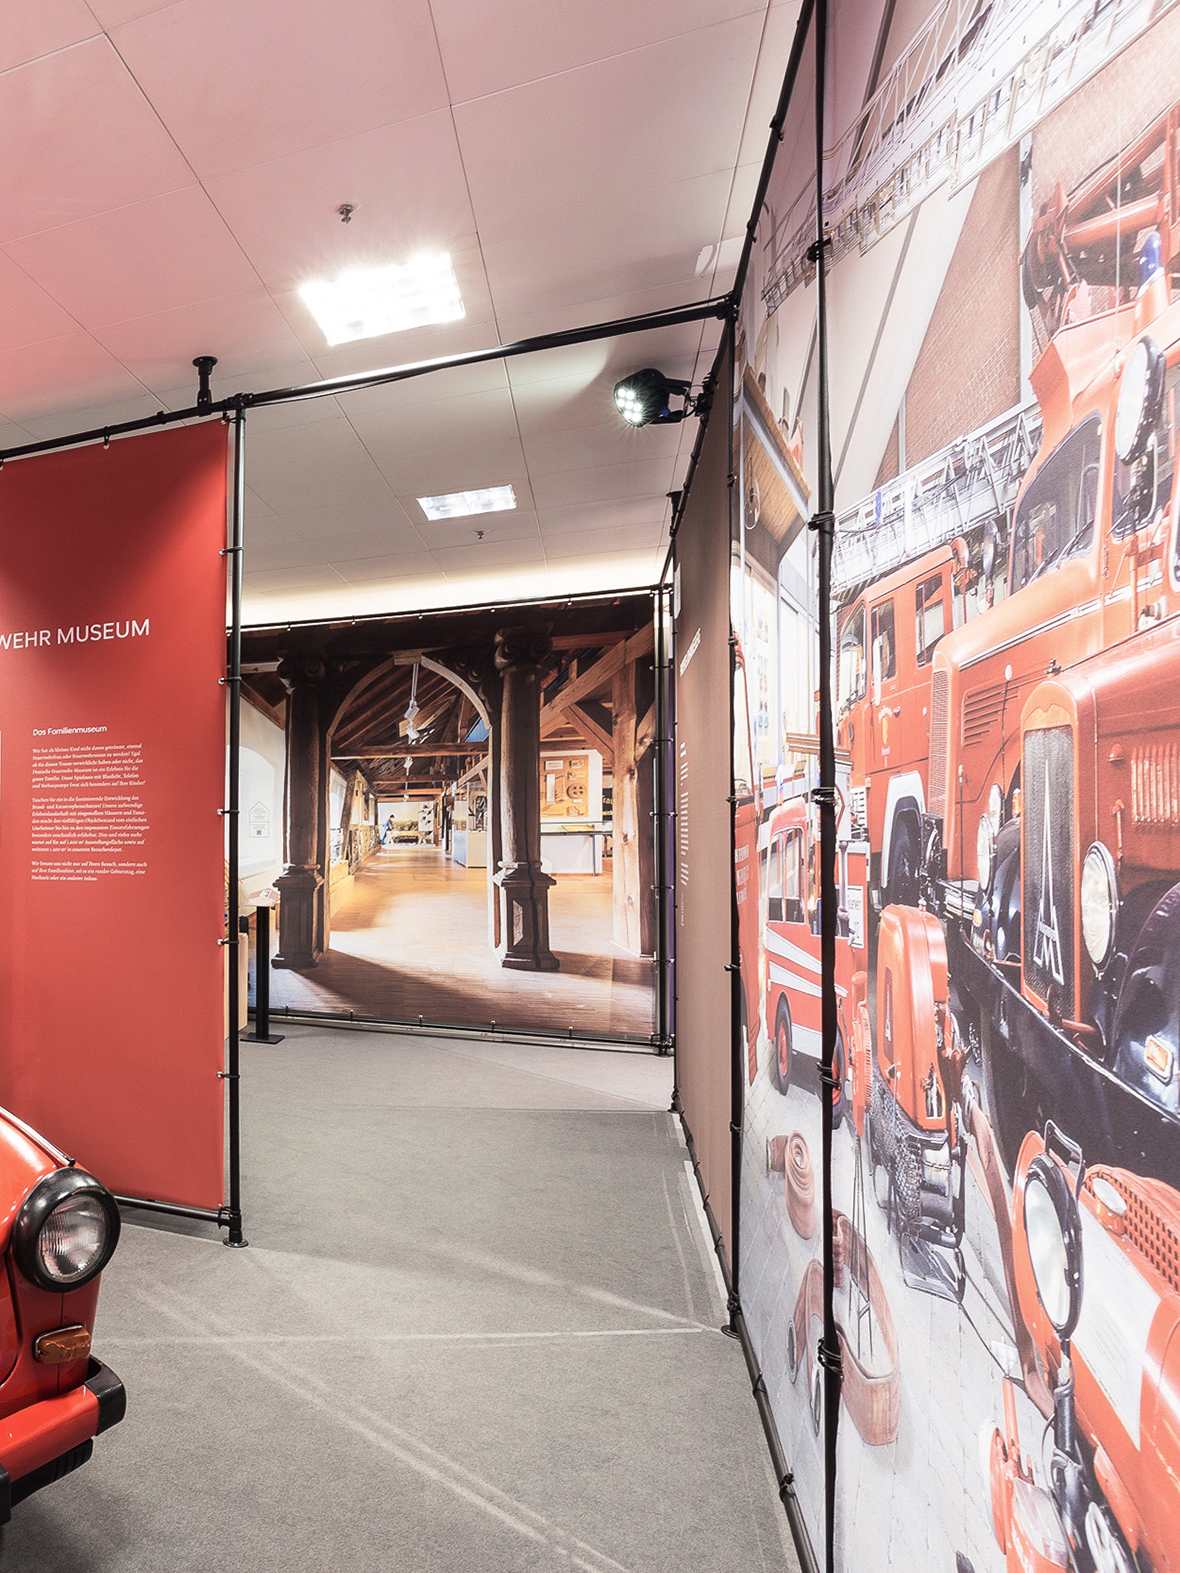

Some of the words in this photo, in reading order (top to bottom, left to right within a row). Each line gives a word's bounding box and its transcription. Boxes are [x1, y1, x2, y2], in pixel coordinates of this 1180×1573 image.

[57, 618, 151, 645] MUSEUM
[32, 728, 46, 737] Das
[47, 725, 108, 736] Familienmuseum
